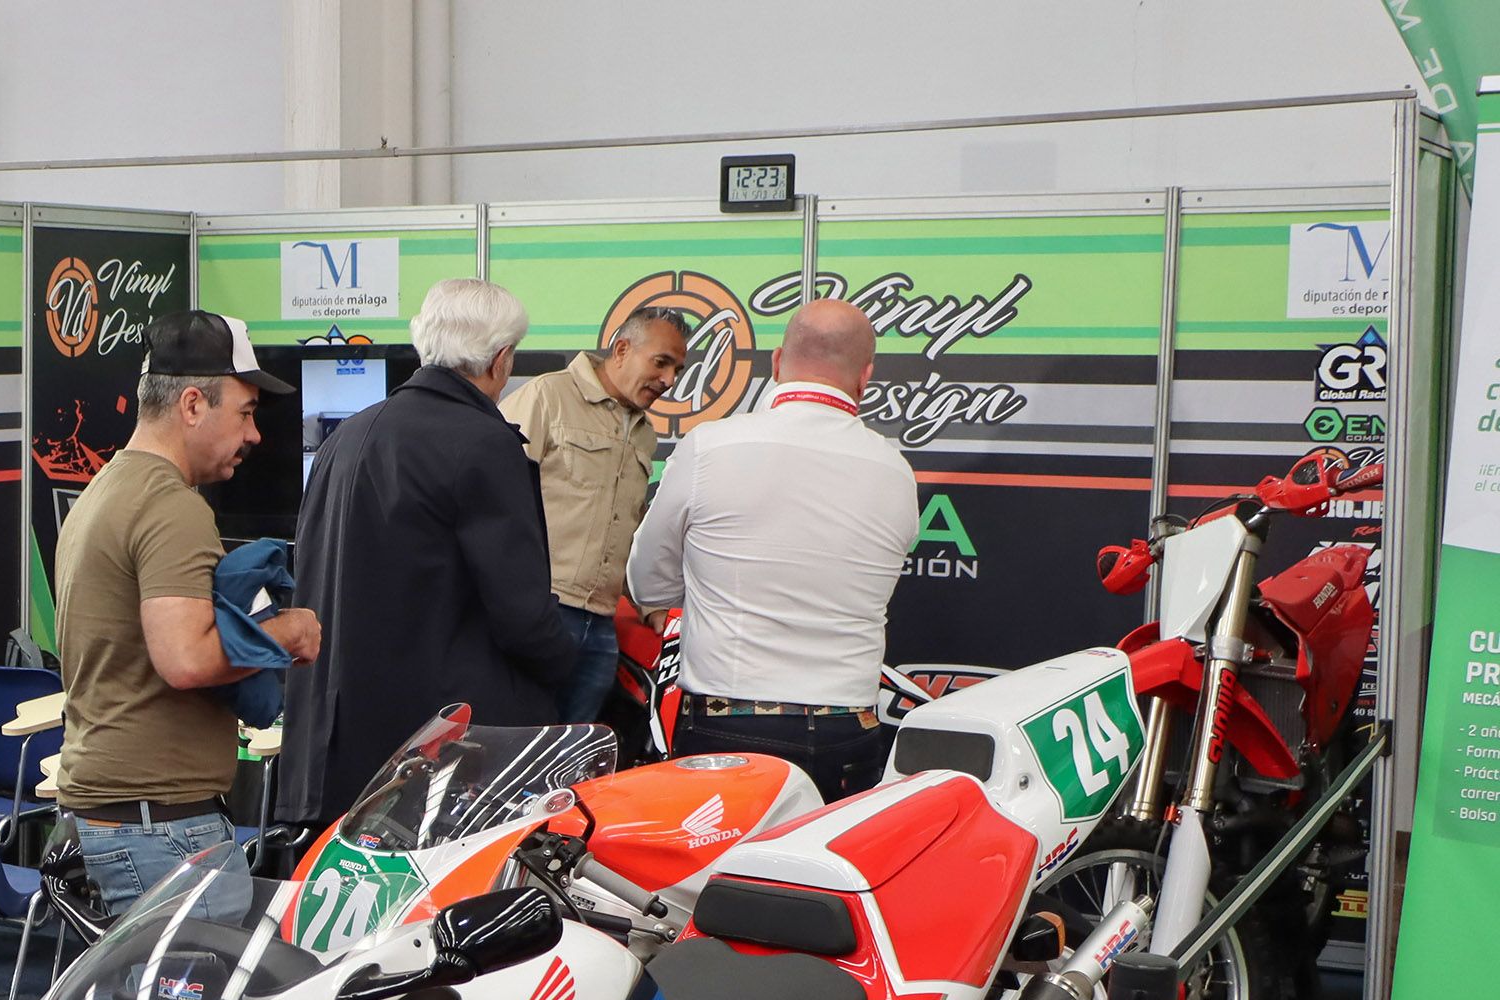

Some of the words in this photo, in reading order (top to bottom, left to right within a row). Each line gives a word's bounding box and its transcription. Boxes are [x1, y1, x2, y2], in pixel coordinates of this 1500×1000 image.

[737, 168, 779, 188] 12:23
[97, 258, 176, 309] Vinyl
[291, 296, 333, 311] diputación
[334, 295, 344, 305] de
[347, 294, 387, 308] málaga
[1303, 288, 1362, 304] diputación
[1364, 287, 1378, 301] de
[312, 309, 322, 317] es
[324, 307, 361, 318] deporte
[1332, 304, 1346, 315] es
[96, 308, 154, 356] Des
[1320, 389, 1357, 400] Global
[860, 370, 1030, 447] esign
[1468, 725, 1476, 737] 2
[1052, 691, 1130, 797] 24
[1459, 807, 1497, 822] Bolsa
[357, 833, 381, 849] HRC
[687, 826, 743, 849] HONDA
[1036, 827, 1079, 881] HRC
[339, 858, 368, 873] HONDA
[300, 867, 381, 952] 24
[1094, 919, 1137, 969] HRC
[158, 977, 204, 999] HRC
